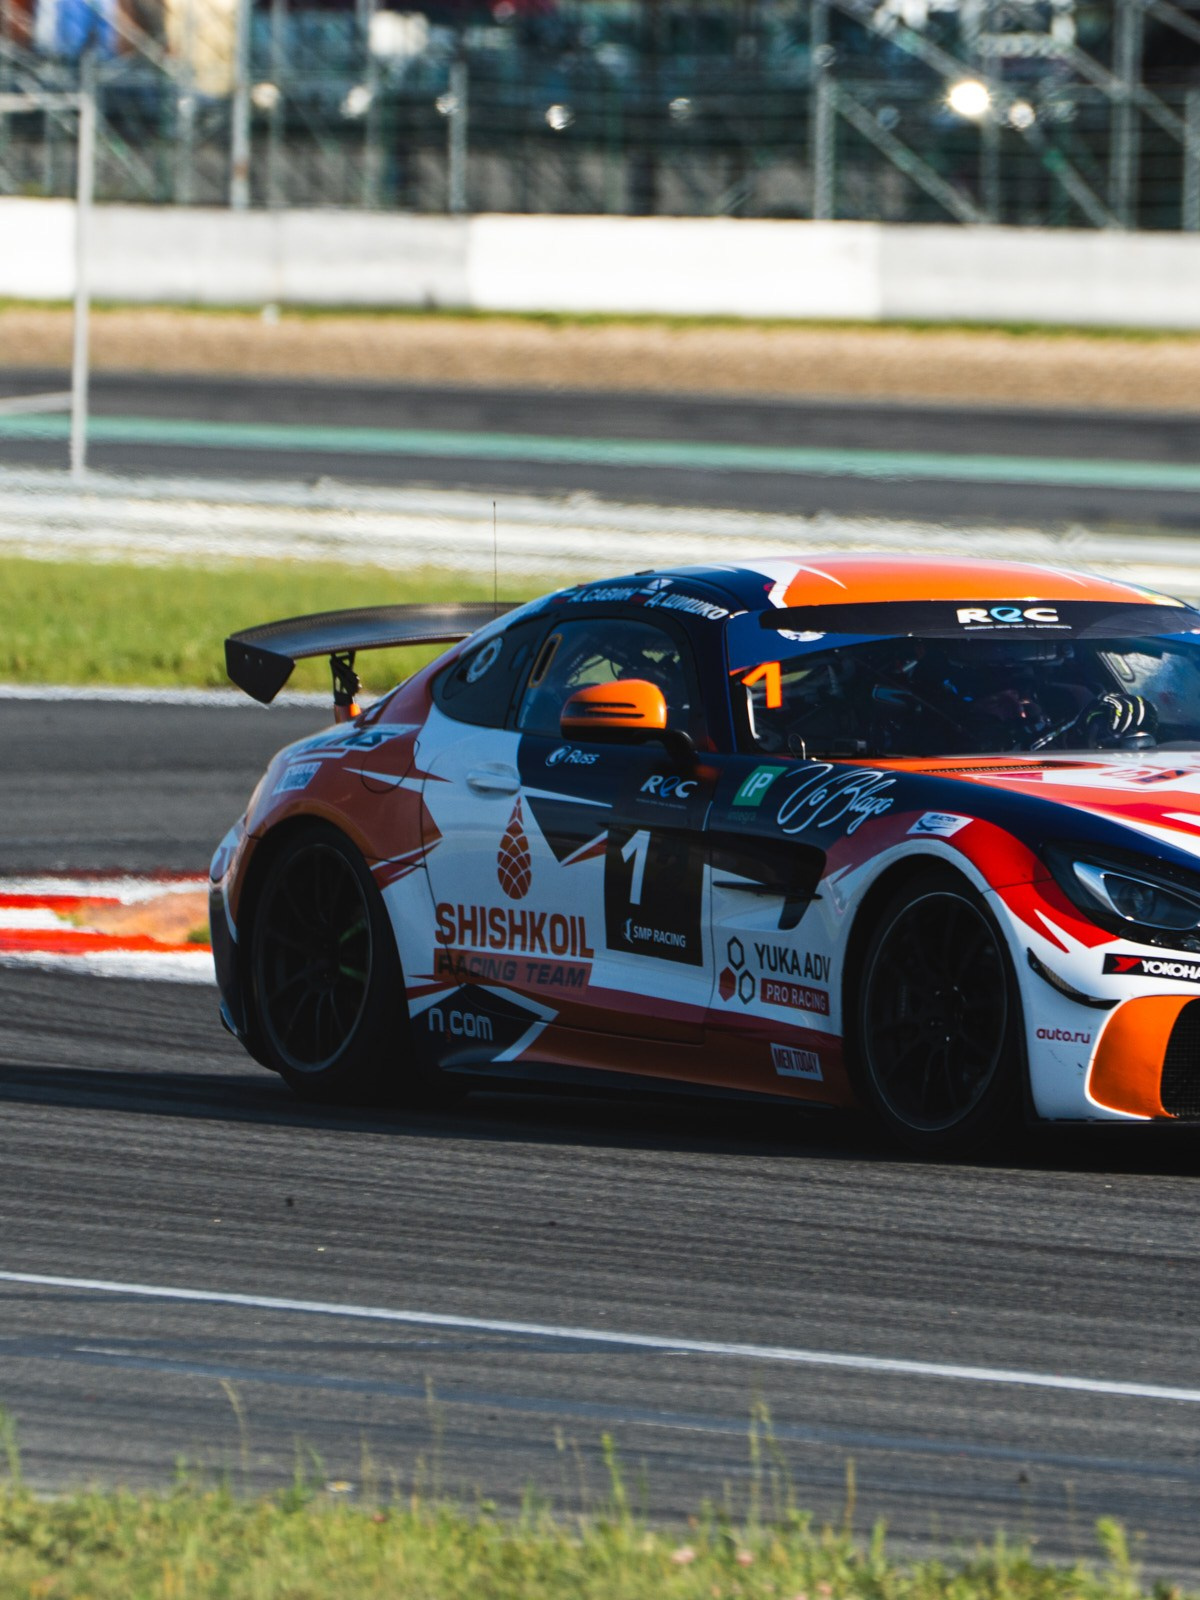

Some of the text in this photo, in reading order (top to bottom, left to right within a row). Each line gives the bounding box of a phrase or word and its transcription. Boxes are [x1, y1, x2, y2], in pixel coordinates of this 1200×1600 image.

[741, 660, 783, 709] 1
[741, 773, 774, 797] IP
[620, 829, 651, 906] 1
[435, 902, 594, 959] SHISHKOIL
[633, 926, 687, 948] SMP RACING
[437, 954, 586, 989] RACING TEAM
[754, 942, 832, 983] YUKA ADV
[766, 984, 826, 1011] PRO RACING
[1036, 1027, 1091, 1044] auto.ru
